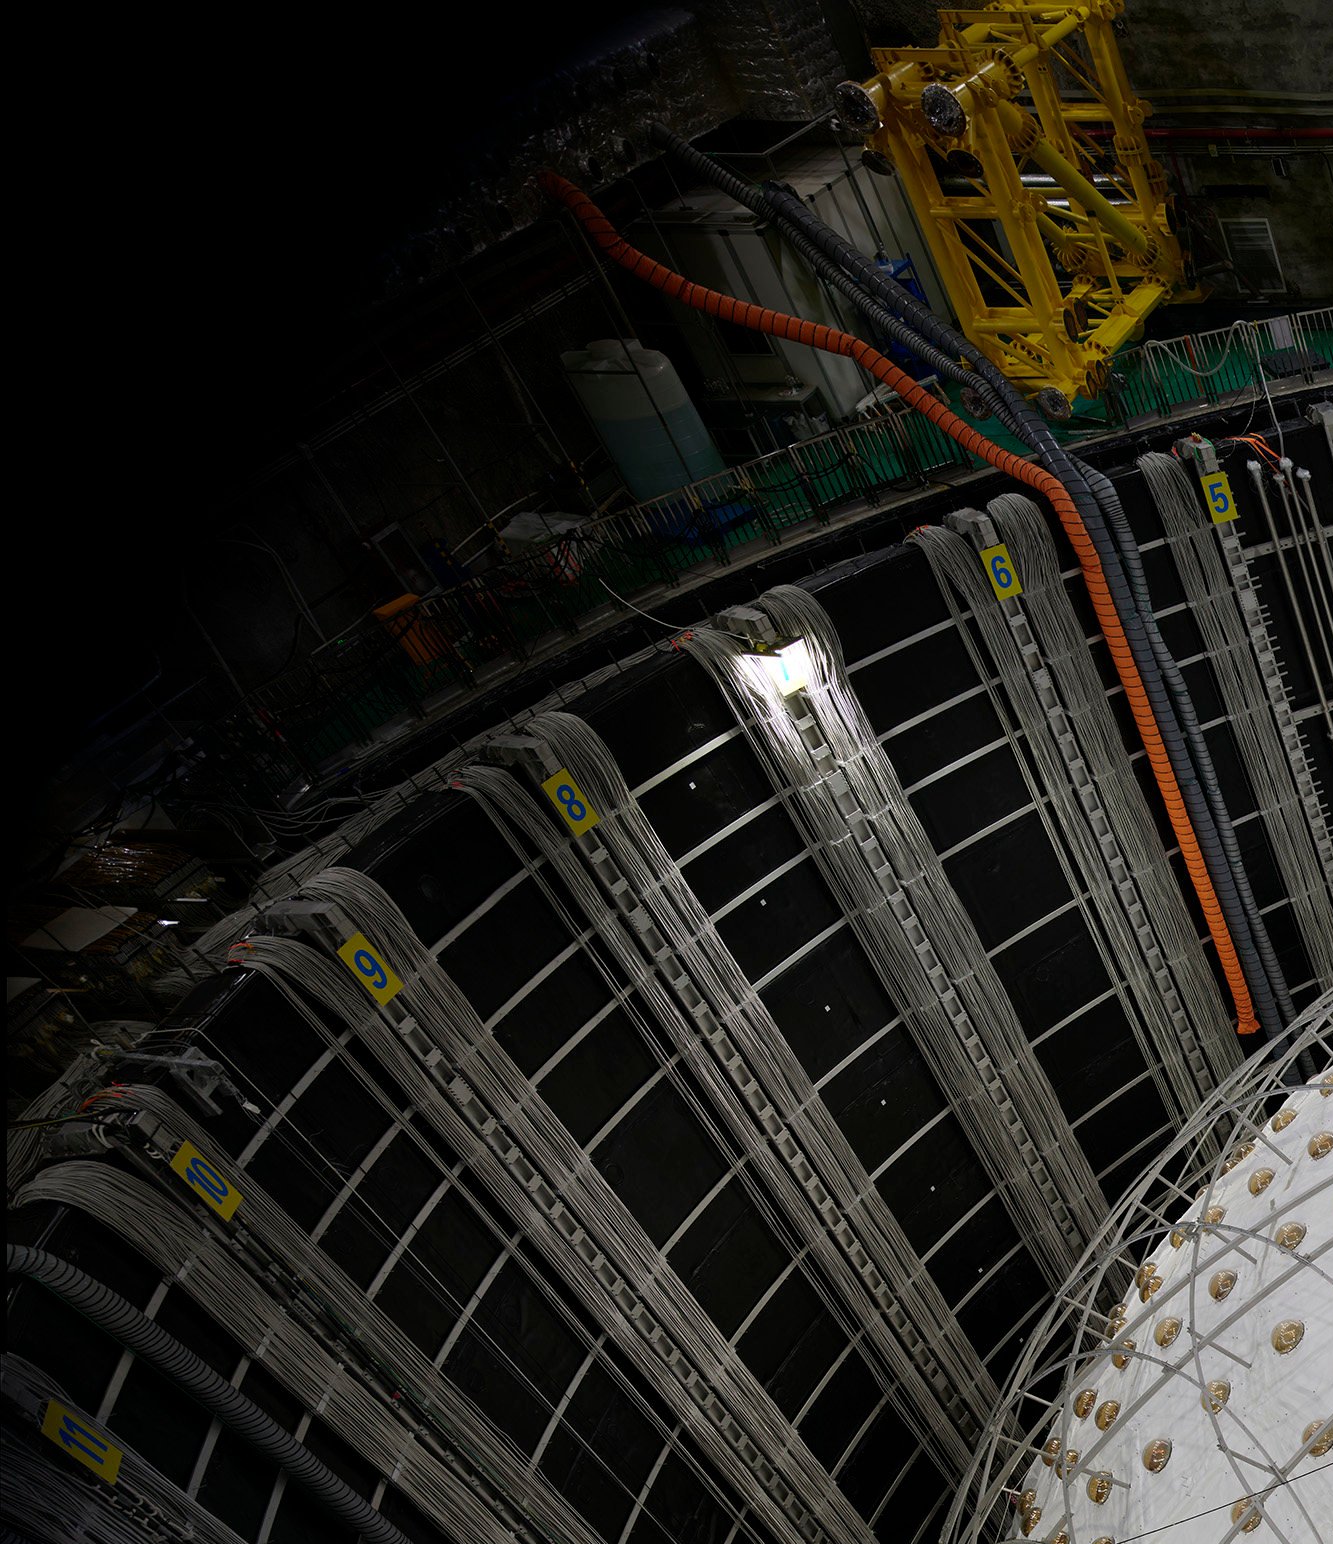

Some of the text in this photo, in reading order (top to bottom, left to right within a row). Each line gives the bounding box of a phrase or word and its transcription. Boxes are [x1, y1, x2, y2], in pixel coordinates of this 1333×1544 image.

[1208, 482, 1228, 513] 5
[992, 556, 1012, 588] 6
[557, 786, 586, 820] 8
[354, 950, 386, 989] 9
[186, 1157, 228, 1204] 10
[60, 1415, 108, 1465] 11
